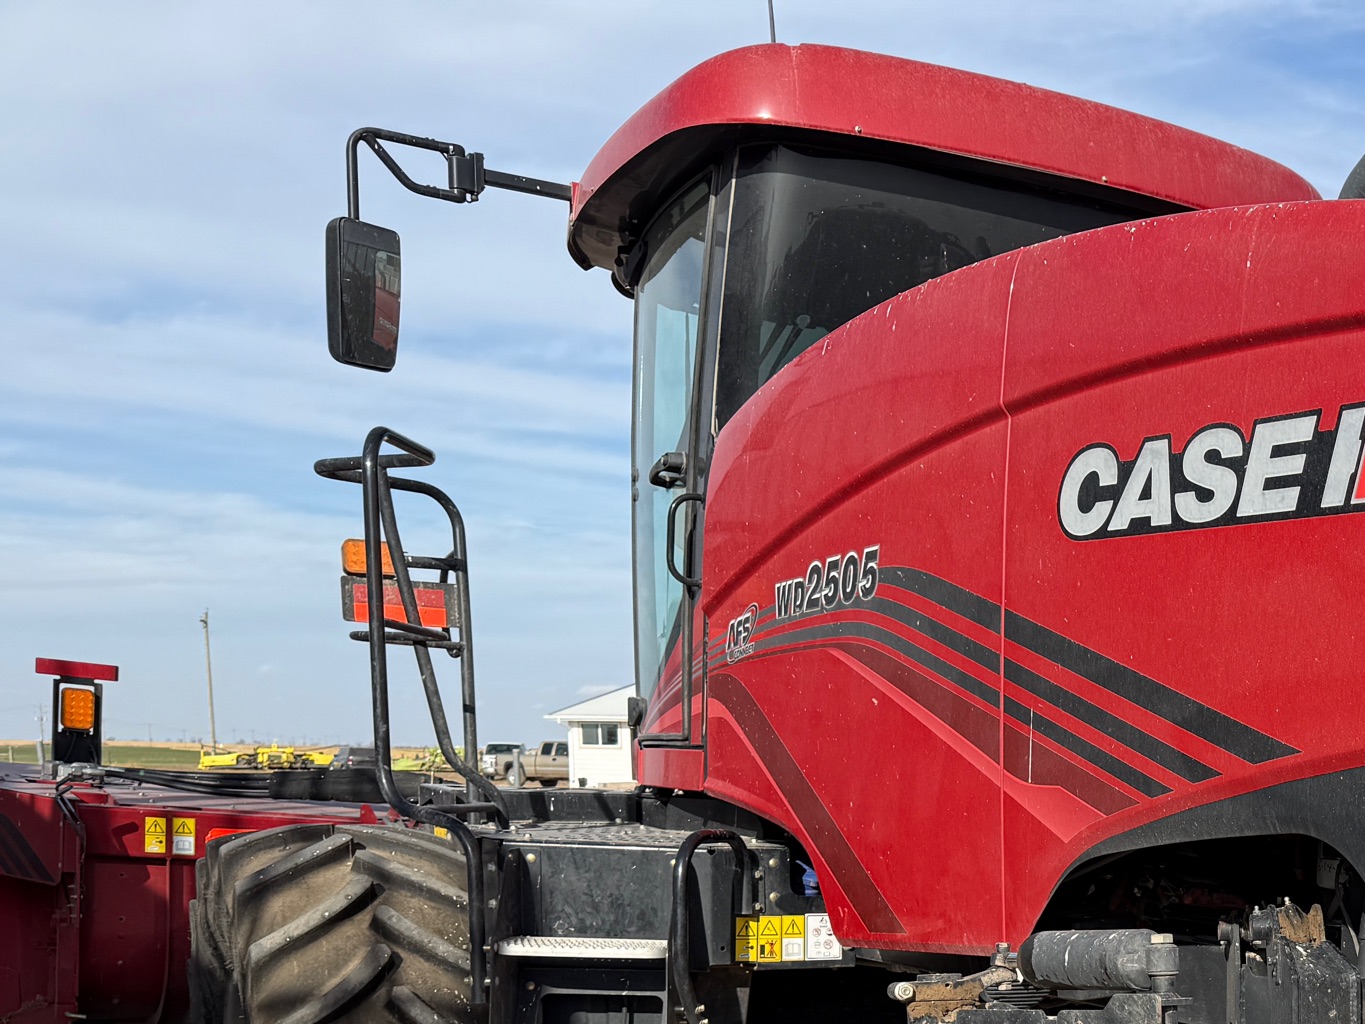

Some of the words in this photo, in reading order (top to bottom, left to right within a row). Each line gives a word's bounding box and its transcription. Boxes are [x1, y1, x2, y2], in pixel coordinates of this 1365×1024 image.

[1059, 414, 1318, 537] CASE
[774, 544, 881, 620] WD2505
[726, 611, 752, 653] AFS
